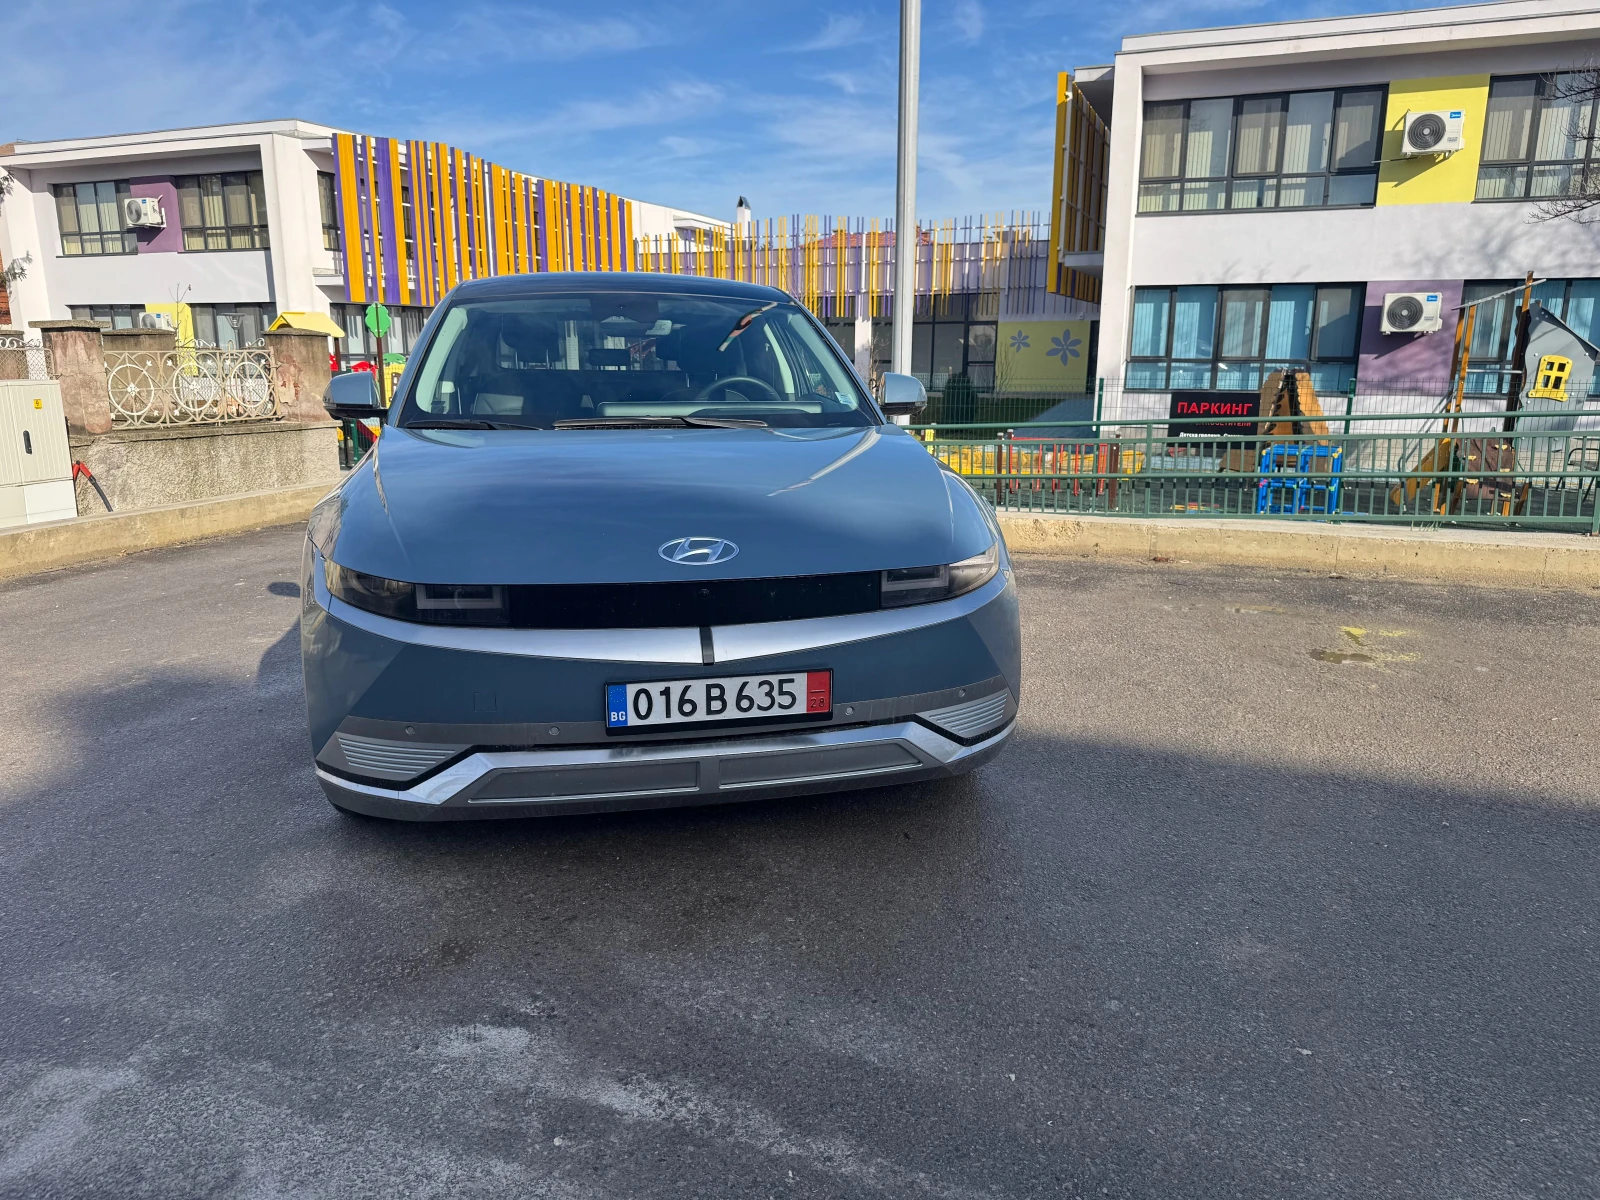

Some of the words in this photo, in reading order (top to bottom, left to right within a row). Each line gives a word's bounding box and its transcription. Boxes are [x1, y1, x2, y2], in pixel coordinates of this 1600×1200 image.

[1177, 401, 1253, 415] ПАРКИНГ
[810, 697, 825, 709] 28
[610, 711, 626, 722] BG
